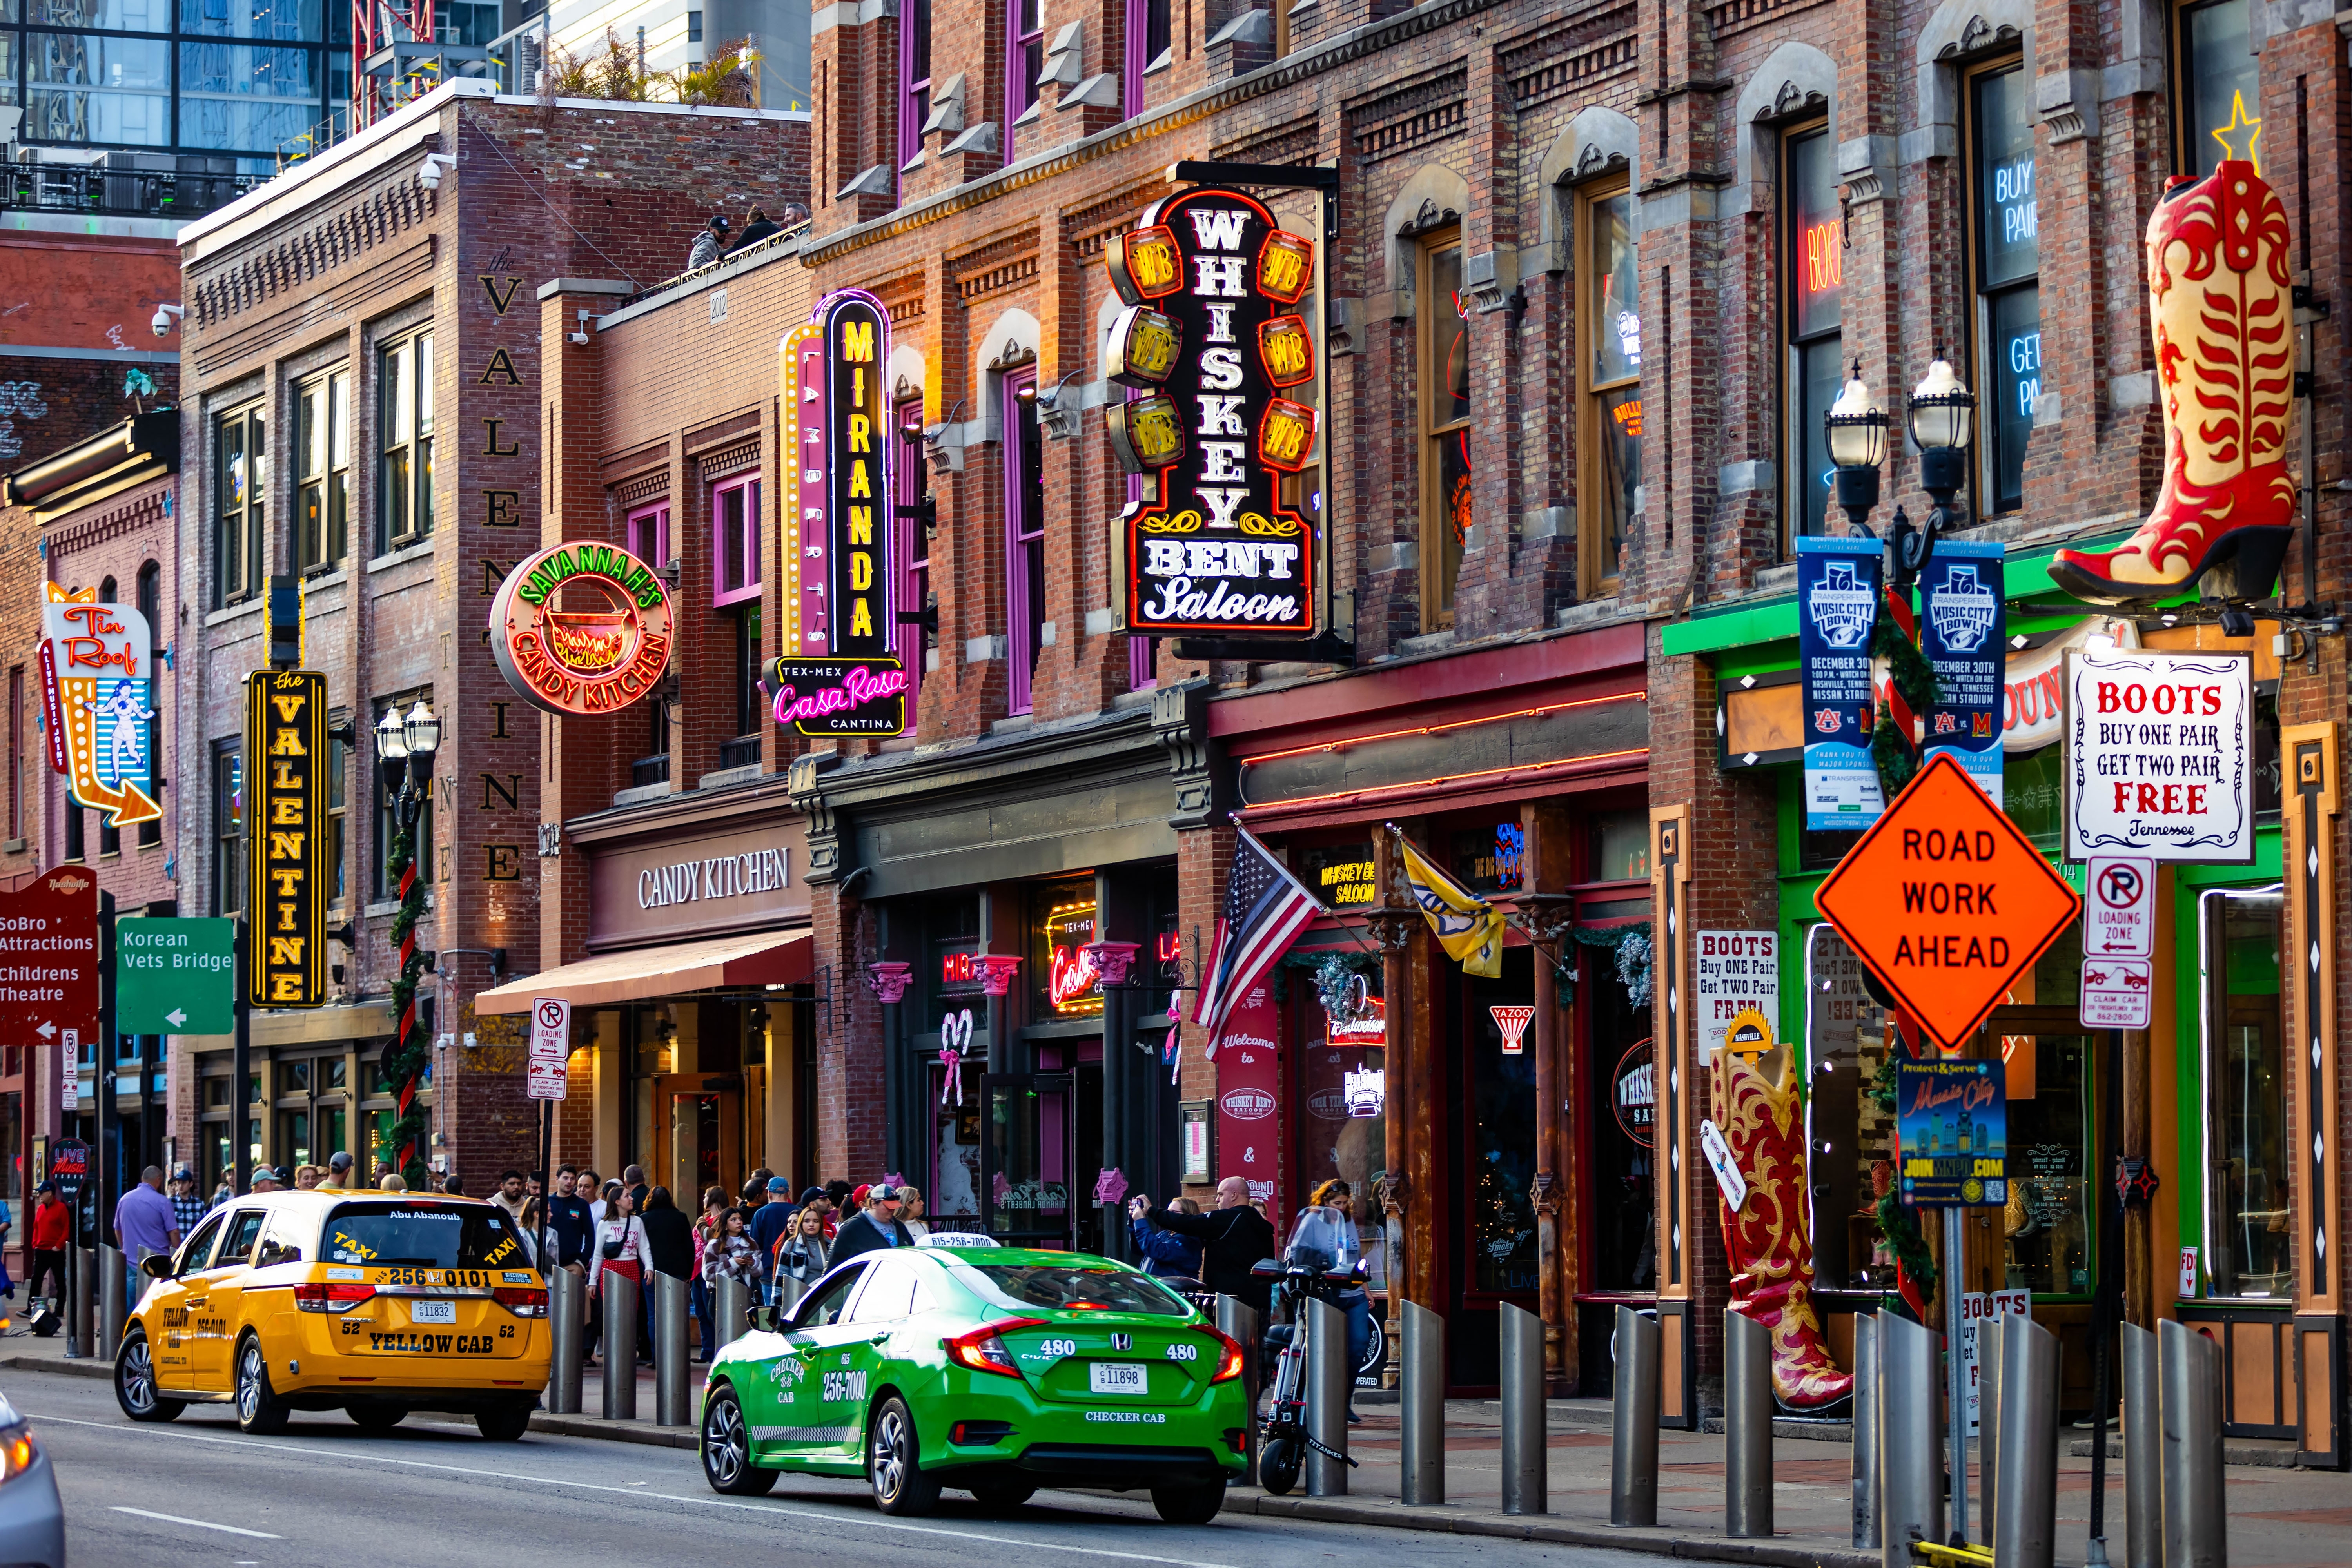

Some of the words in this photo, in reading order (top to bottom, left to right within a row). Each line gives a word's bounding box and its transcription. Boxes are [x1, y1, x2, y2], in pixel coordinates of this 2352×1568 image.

[1996, 160, 2033, 202] BUY
[1133, 242, 1172, 287] WB
[1262, 248, 1302, 291] WB
[711, 295, 726, 319] 2012
[1132, 326, 1172, 371] WB
[1271, 331, 1305, 374] WB
[1188, 209, 1251, 529] WHISKEY
[1136, 412, 1175, 456] WB
[1265, 415, 1304, 458] WB
[842, 321, 873, 637] MIRANDA
[804, 350, 826, 643] LAMBERT'S
[1144, 540, 1297, 579] BENT
[519, 545, 663, 608] SAVANNAH'S
[1144, 575, 1298, 622] Saloon
[1812, 603, 1845, 619] MUSIC
[1847, 603, 1872, 618] CITY
[1933, 606, 1965, 622] MUSIC
[1968, 607, 1993, 622] CITY
[64, 606, 124, 635] Tin
[1827, 616, 1857, 626] BOWL
[1947, 619, 1976, 630] BOWL
[62, 636, 137, 675] Roof
[1812, 657, 1855, 669] DECEMBER
[513, 633, 579, 704] CANDY
[584, 633, 666, 709] KITCHEN
[782, 668, 842, 677] TEX-MEX
[1933, 661, 1970, 673] DECEMBER
[1973, 662, 1994, 673] 30TH
[273, 672, 304, 689] the
[1812, 680, 1846, 689] NASHVILLE,
[773, 685, 849, 723] Casa
[842, 666, 910, 708] Rosa
[1813, 690, 1842, 700] NISSAN
[1959, 694, 1993, 704] STADIUM
[2097, 682, 2221, 716] BOOTS
[48, 688, 58, 726] MUSIC
[54, 728, 64, 767] JOINT
[830, 719, 894, 729] CANTINA
[2100, 723, 2134, 746] BUY
[2139, 723, 2171, 747] ONE
[2179, 724, 2222, 753] PAIR
[2097, 754, 2131, 777] GET
[2135, 754, 2174, 777] TWO
[2181, 755, 2224, 784] PAIR
[2113, 782, 2208, 815] FREE
[2130, 819, 2195, 836] Tennessee
[269, 694, 307, 1004] VALENTINE
[1903, 829, 1995, 861] ROAD
[1321, 863, 1363, 886] WHISKEY
[1475, 858, 1484, 878] THE
[1486, 856, 1494, 877] BIG
[49, 878, 89, 891] Nashville
[638, 860, 700, 909] CANDY
[704, 847, 789, 899] KITCHEN
[1336, 883, 1375, 904] SALOON
[1902, 882, 1997, 915] WORK
[0, 916, 46, 931] SoBro
[1064, 919, 1094, 933] TEX-MEX
[2099, 911, 2140, 924] LOADING
[124, 932, 187, 947] Korean
[2106, 927, 2132, 940] ZONE
[0, 935, 93, 951] Attractions
[1702, 936, 1772, 956] BOOTS
[1893, 935, 2009, 968] AHEAD
[125, 954, 163, 968] Vets
[172, 953, 232, 972] Bridge
[1700, 959, 1721, 978] Buy
[1726, 959, 1748, 974] ONE
[1752, 960, 1775, 975] Pair
[0, 967, 79, 980] Childrens
[0, 987, 64, 1002] Theatre
[1700, 979, 1717, 994] Get
[1722, 979, 1748, 994] TWO
[1753, 980, 1775, 994] Pair
[1494, 1009, 1530, 1017] YAZOO
[538, 1029, 562, 1038] LOADING
[1222, 1033, 1275, 1049] Welcome
[1735, 1032, 1760, 1042] NASHVILLE
[543, 1039, 557, 1047] ZONE
[1241, 1052, 1255, 1063] to
[1903, 1063, 1938, 1073] Protect
[1938, 1063, 1948, 1074] &
[1948, 1064, 1977, 1073] Serve
[1225, 1095, 1254, 1108] WHISKEY
[1256, 1096, 1272, 1108] BENT
[1904, 1076, 1963, 1118] Music
[1963, 1076, 1995, 1110] City
[55, 1148, 85, 1163] LIVE
[1244, 1147, 1254, 1163] &
[1724, 1167, 1741, 1195] COUNTRY
[414, 1212, 460, 1221] Abanoub
[334, 1231, 378, 1260] TAXI
[484, 1237, 517, 1265] TAXI
[932, 1237, 991, 1247] 615-256-7000
[1487, 1240, 1514, 1252] Smoky
[375, 1271, 387, 1283] 615
[390, 1268, 425, 1285] 256
[445, 1270, 492, 1287] 0101
[163, 1308, 190, 1327] YELLOW
[425, 1307, 449, 1317] 11832
[342, 1323, 360, 1335] 52
[499, 1325, 515, 1338] 52
[168, 1329, 181, 1348] CAB
[370, 1333, 453, 1353] YELLOW
[457, 1335, 494, 1353] CAB
[1040, 1339, 1076, 1356] 480
[841, 1353, 850, 1365] 615
[1166, 1344, 1197, 1361] 480
[770, 1357, 804, 1383] CHECKER
[1107, 1371, 1138, 1385] 11898
[823, 1370, 867, 1402] 256-7000
[777, 1392, 794, 1403] CAB
[1085, 1412, 1140, 1422] CHECKER
[1143, 1414, 1165, 1423] CAB
[1309, 1439, 1342, 1459] TITANKER
